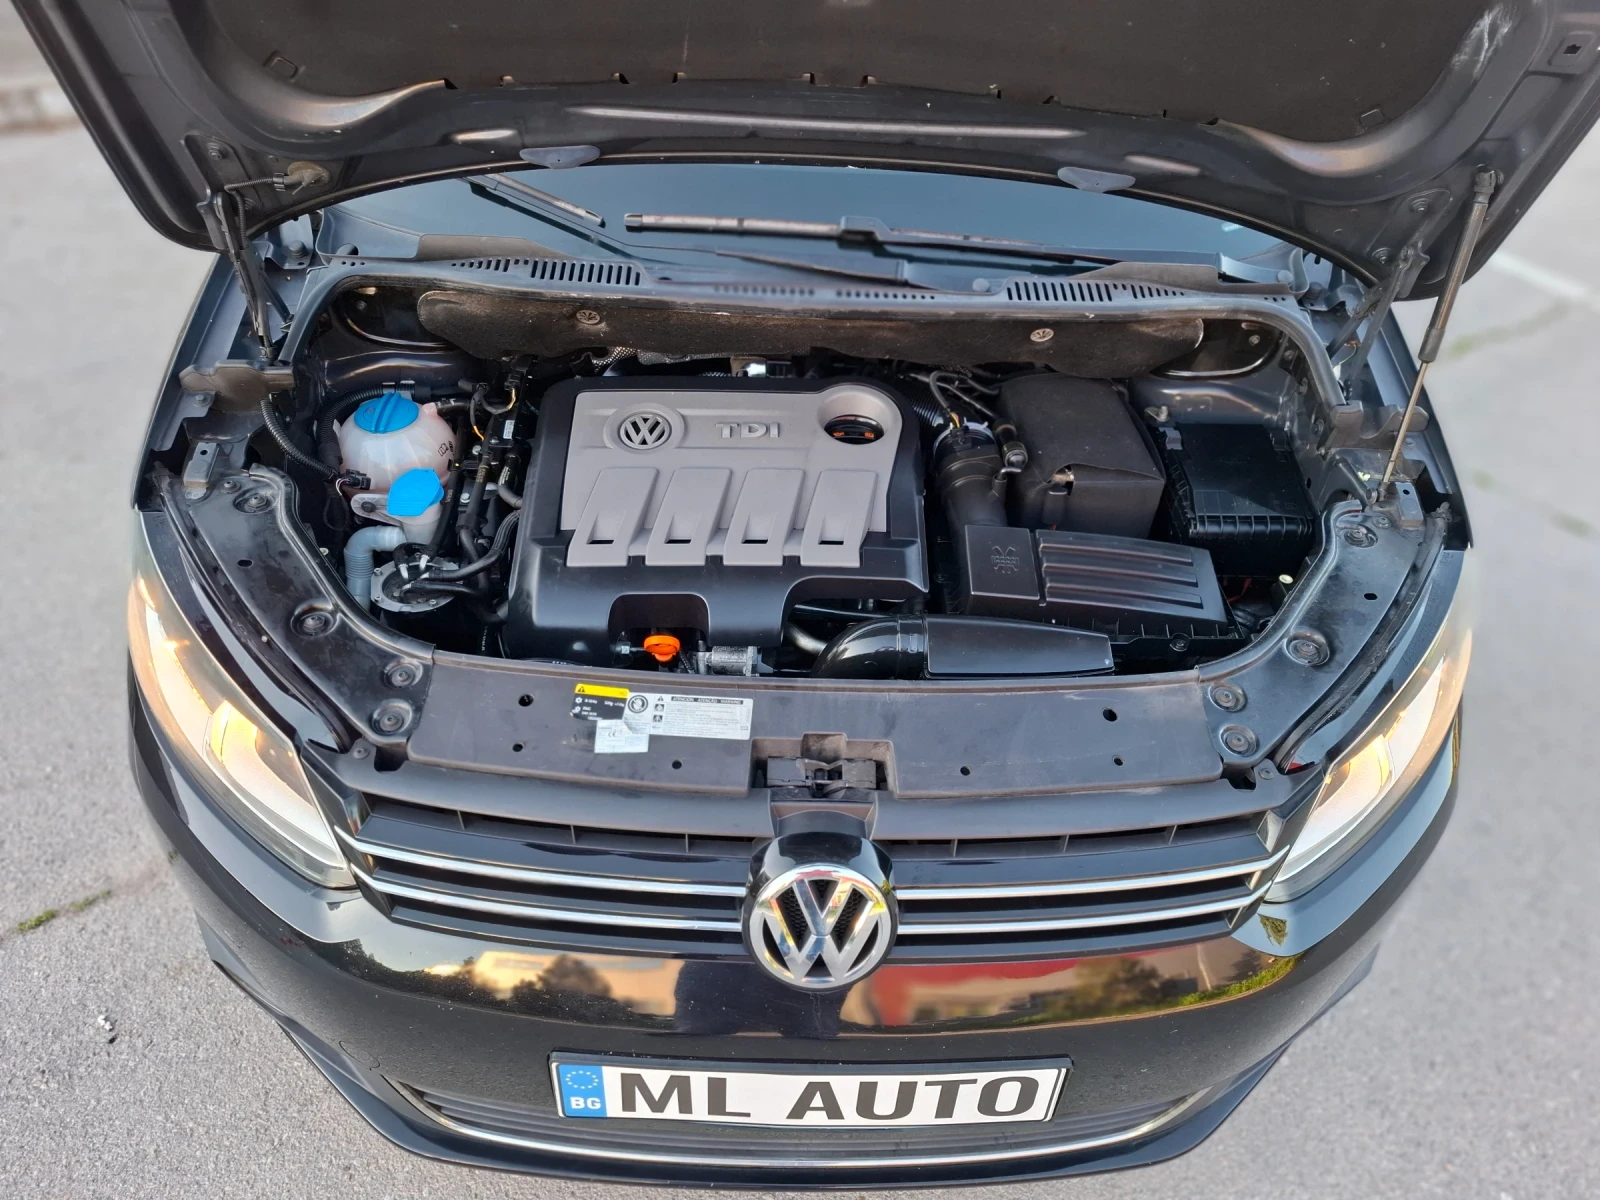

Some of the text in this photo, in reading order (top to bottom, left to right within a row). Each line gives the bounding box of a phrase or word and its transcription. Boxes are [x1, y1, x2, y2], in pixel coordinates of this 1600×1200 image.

[715, 422, 781, 439] TDI
[750, 863, 892, 989] VW
[570, 1096, 602, 1110] BG
[620, 1072, 1040, 1121] ML AUTO
